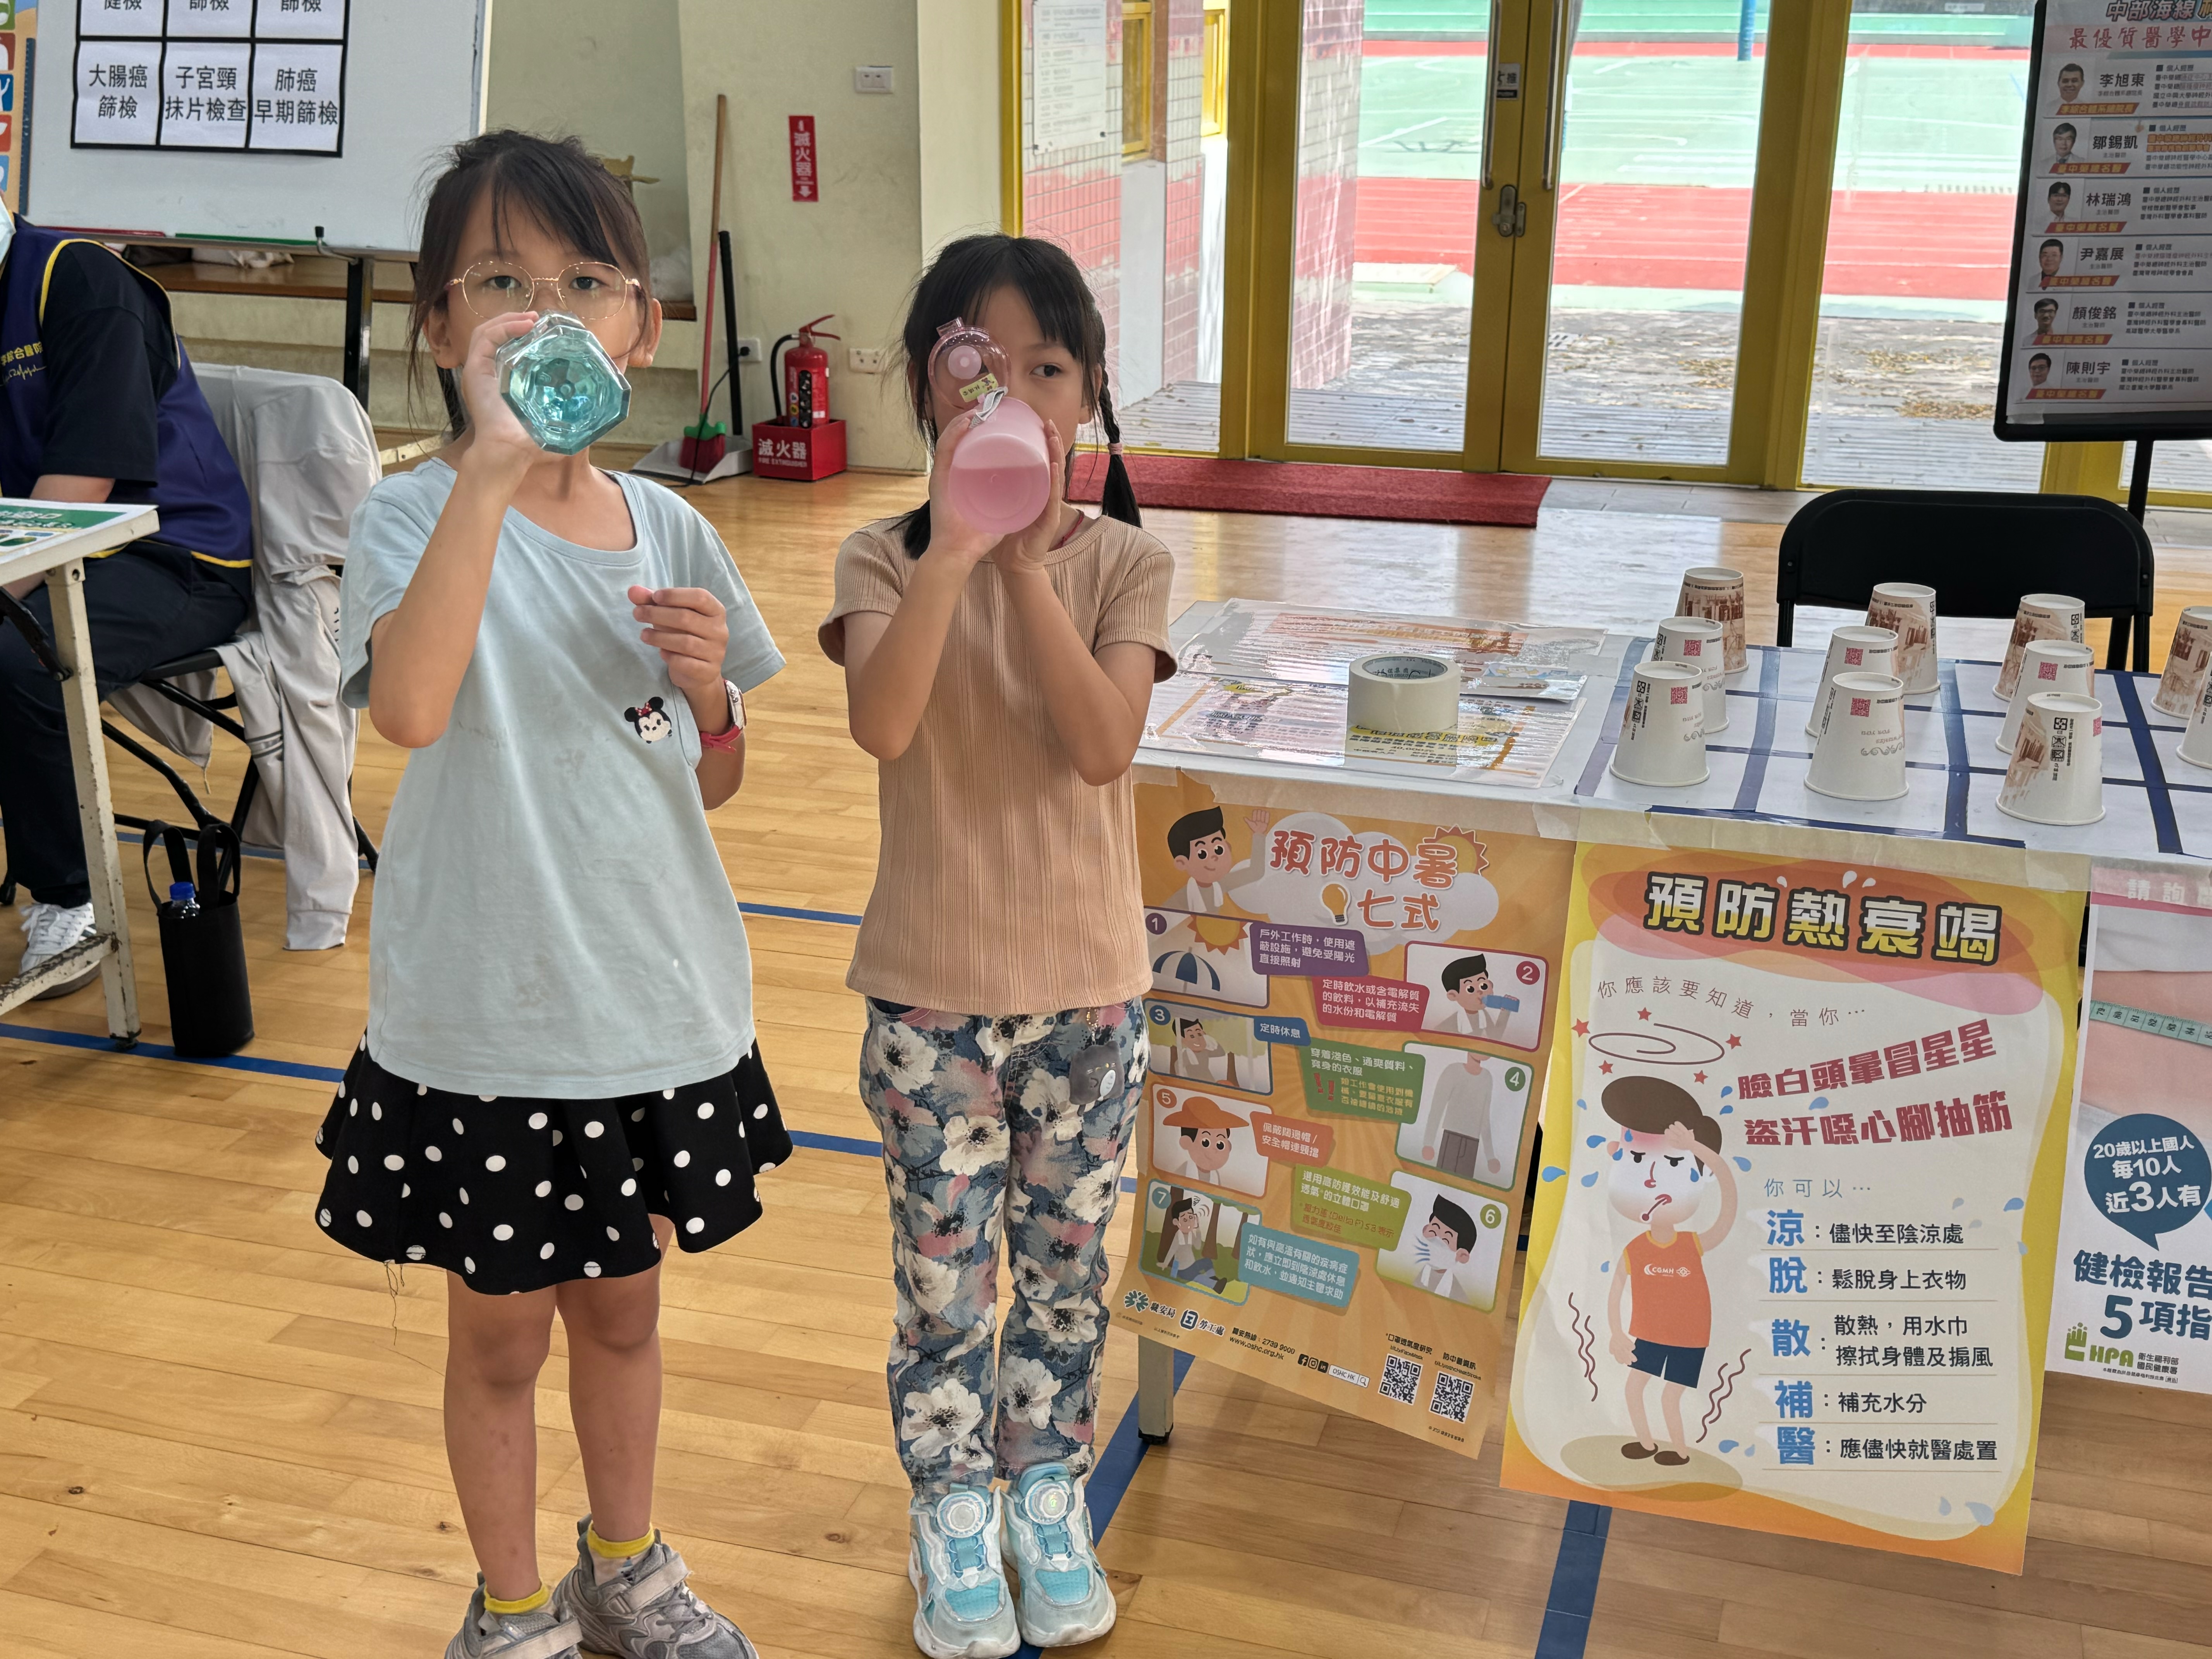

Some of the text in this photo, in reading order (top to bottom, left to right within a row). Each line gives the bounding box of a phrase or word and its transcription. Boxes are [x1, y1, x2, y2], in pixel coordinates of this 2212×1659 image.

[2070, 25, 2212, 50] 最優質醫學中
[89, 64, 148, 89] 大腸癌
[176, 65, 237, 90] 子宮頸
[275, 68, 318, 92] 肺癌
[2100, 73, 2145, 88] 李旭東
[98, 95, 137, 119] 篩檢
[165, 96, 247, 122] 抹片檢查
[254, 99, 338, 125] 早期篩檢
[2093, 135, 2138, 149] 鄒錫凱
[794, 132, 812, 177] 滅火器
[2086, 192, 2131, 206] 林瑞鴻
[2080, 247, 2124, 261] 尹嘉展
[2072, 306, 2116, 320] 顏俊銘
[2066, 361, 2110, 375] 陳則宇
[758, 438, 807, 460] 滅火器
[1269, 830, 1457, 889] 預防中暑
[1357, 889, 1440, 931] 七式
[1643, 871, 2002, 965] 預防熱衰竭
[1152, 918, 1158, 930] 1
[1259, 954, 1301, 968] 直接照射
[1521, 965, 1533, 981] 2
[1322, 979, 1420, 1001] 定時飲水或含電解質
[1154, 1009, 1165, 1021] 3
[1322, 1003, 1397, 1022] 的水份和電解質
[2096, 1007, 2106, 1015] 79
[2113, 1010, 2123, 1020] 80
[2131, 1014, 2140, 1023] 81
[1260, 1023, 1300, 1038] 定時休息
[2148, 1017, 2157, 1027] 82
[2166, 1022, 2177, 1032] 83
[2185, 1026, 2195, 1036] 84
[1311, 1059, 1363, 1077] 寬身的衣服
[1738, 1019, 1997, 1099] 臉白頭暈冒星星
[1509, 1072, 1520, 1086] 4
[1161, 1093, 1171, 1104] 5
[1744, 1090, 2013, 1146] 盜汗噁心腳抽筋
[2093, 1135, 2195, 1159] 20歲以上國人
[2112, 1154, 2182, 1180] 每10人
[1158, 1191, 1167, 1204] 7
[2105, 1181, 2201, 1214] 近3人有
[1486, 1209, 1496, 1224] 6
[2073, 1250, 2212, 1301] 健檢報告
[1150, 1302, 1176, 1318] 職安局
[2100, 1294, 2212, 1340] 5項指
[1834, 1315, 1968, 1336] 散熱，用水巾
[1230, 1336, 1284, 1360] www.oshc.org.hk
[1262, 1338, 1278, 1348] 2739
[1279, 1344, 1295, 1354] 9000
[1836, 1346, 1994, 1367] 擦拭身體及搧風
[2089, 1345, 2134, 1368] HPA
[2138, 1352, 2179, 1365] 衛生福利部
[2137, 1362, 2178, 1374] 國民健康署
[1838, 1393, 1927, 1413] 補充水分
[1840, 1439, 1998, 1461] 應儘快就醫處置
